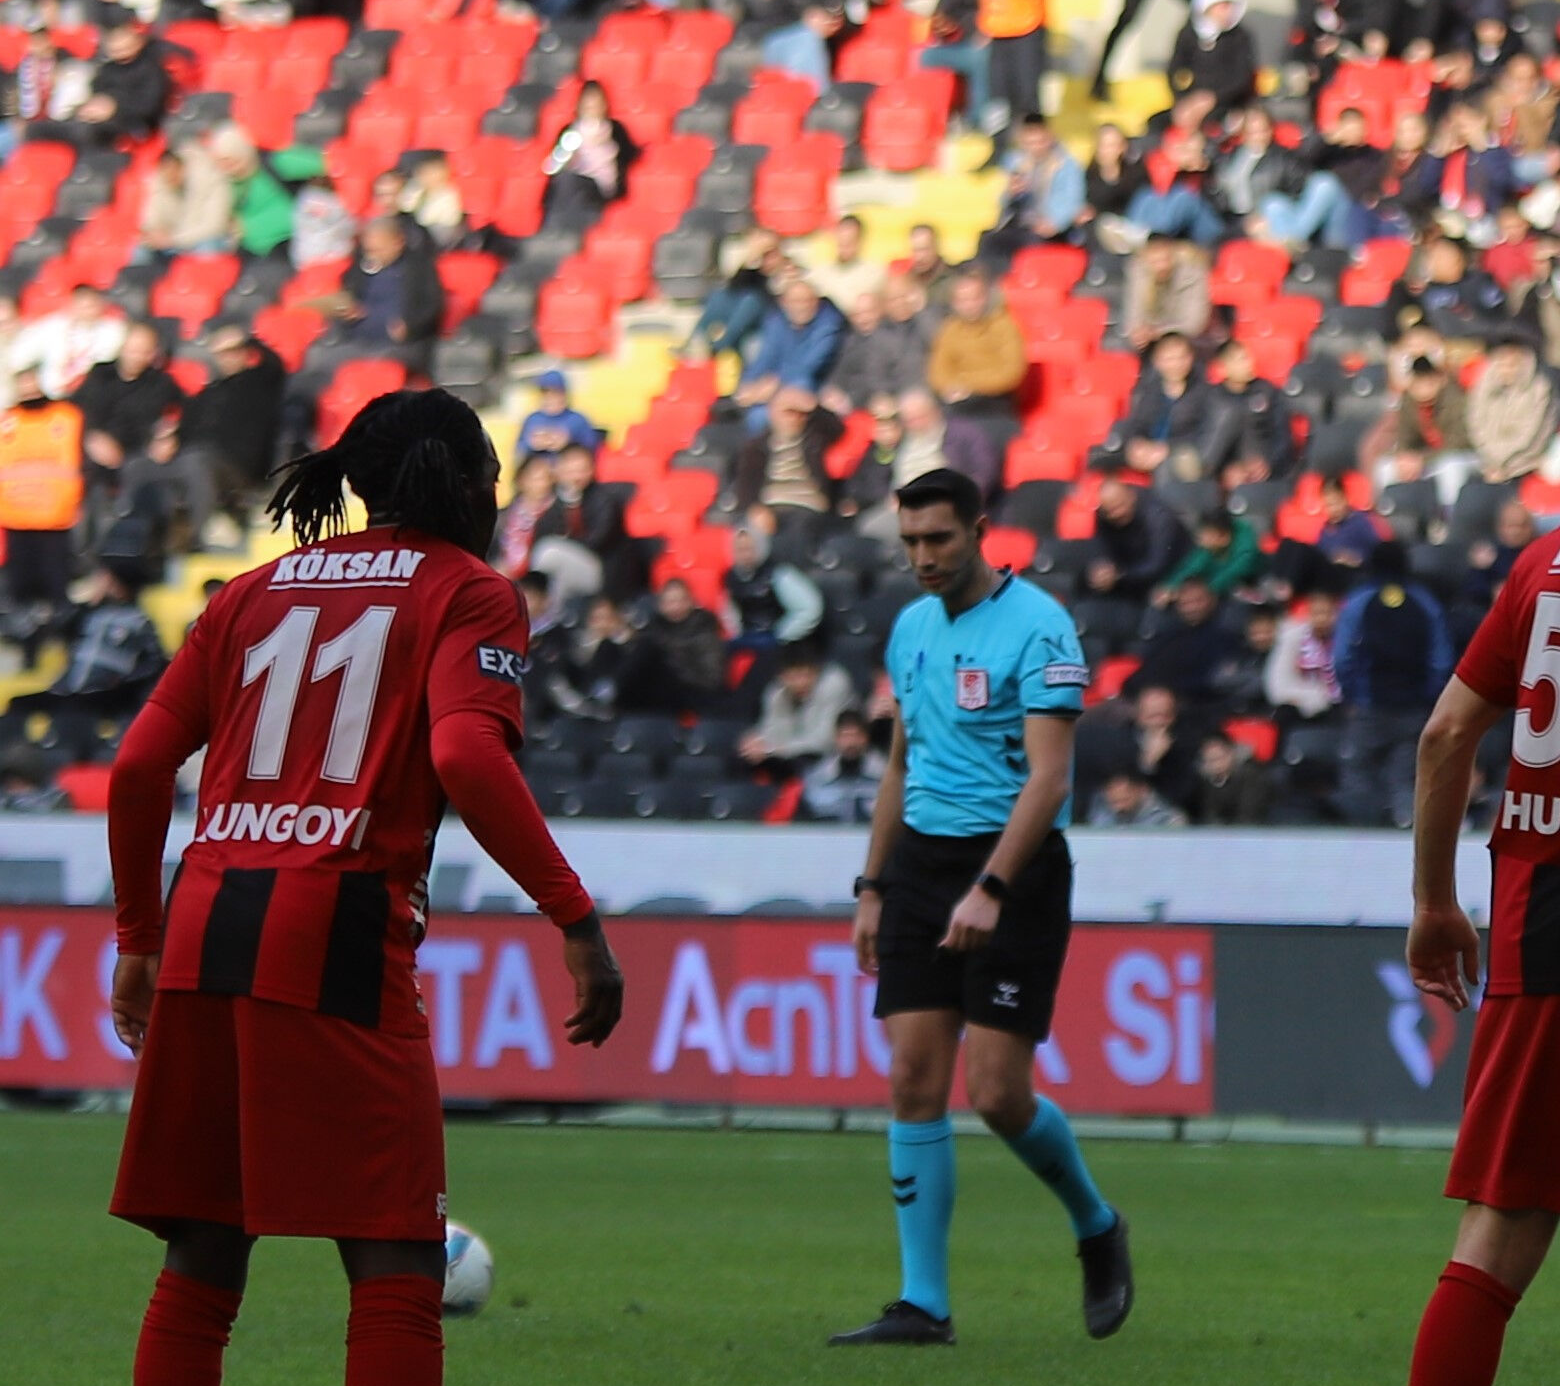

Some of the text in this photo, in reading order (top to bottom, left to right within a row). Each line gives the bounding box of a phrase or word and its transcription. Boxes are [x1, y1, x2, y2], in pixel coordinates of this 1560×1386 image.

[271, 547, 426, 584] KÖKSAN
[242, 605, 397, 785] 11
[1100, 948, 1208, 1089] Si
